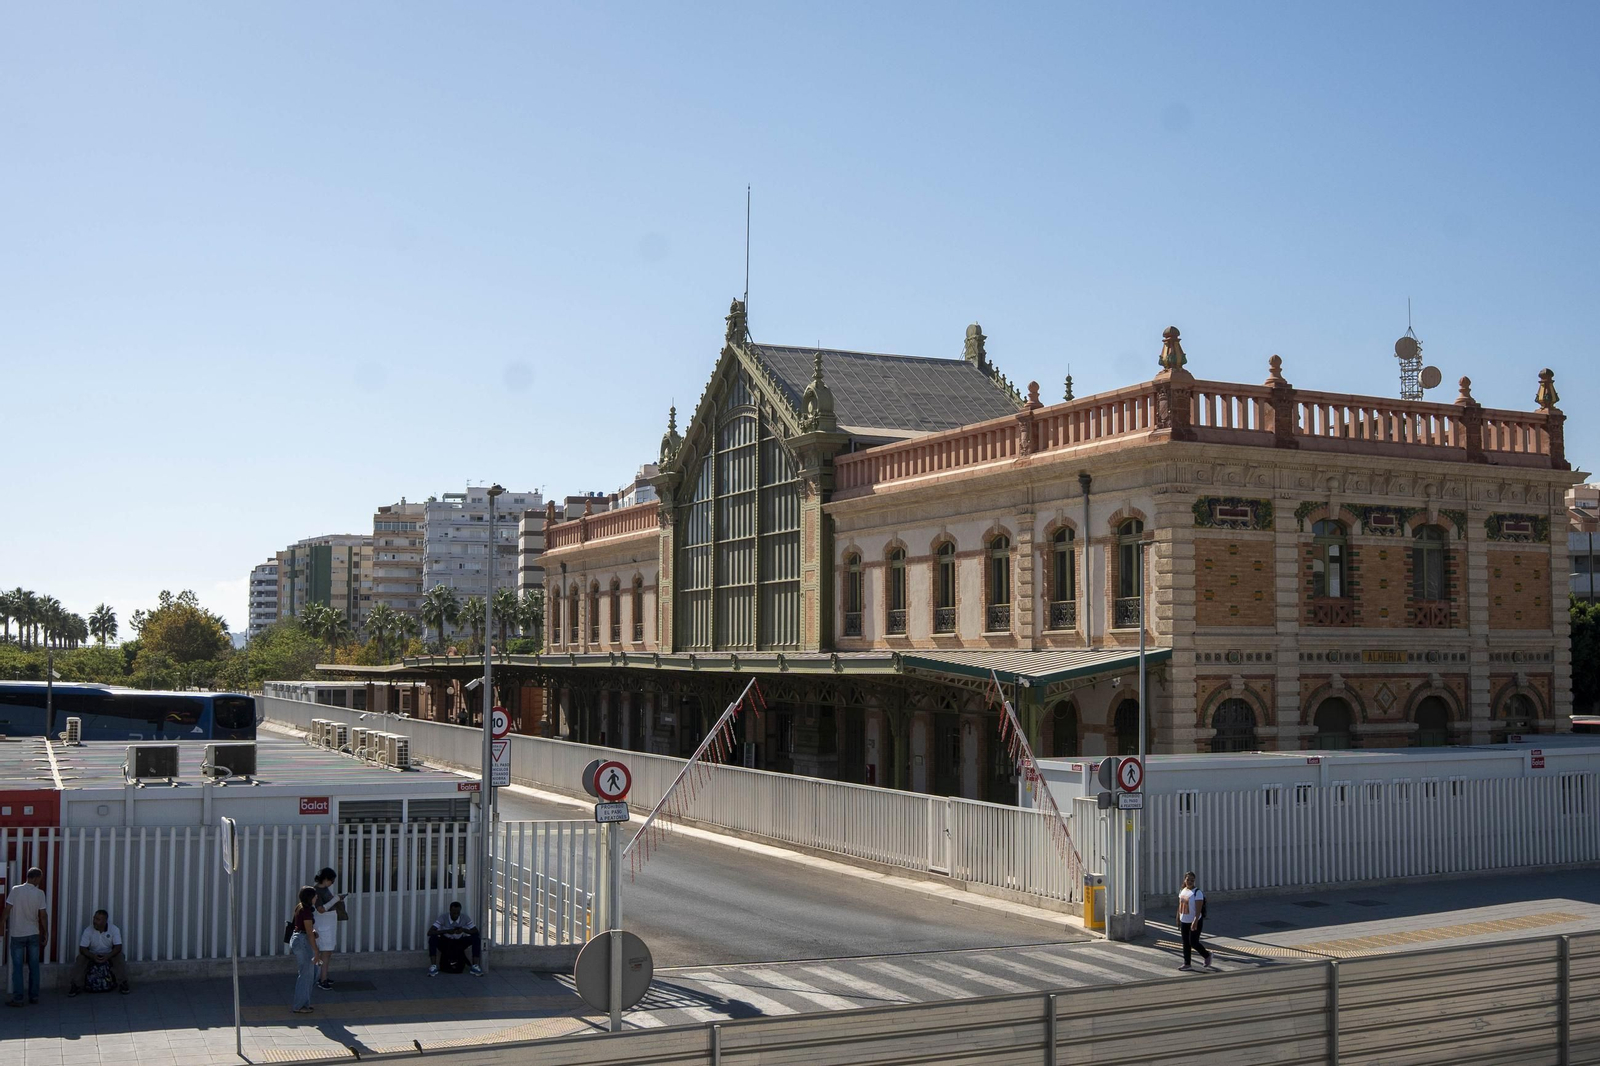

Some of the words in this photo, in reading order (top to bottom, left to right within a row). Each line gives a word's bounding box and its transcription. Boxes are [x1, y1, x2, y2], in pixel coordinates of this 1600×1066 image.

[1368, 651, 1402, 662] ALMERIA
[492, 717, 503, 728] 10
[461, 783, 478, 791] balat
[301, 799, 328, 810] balat
